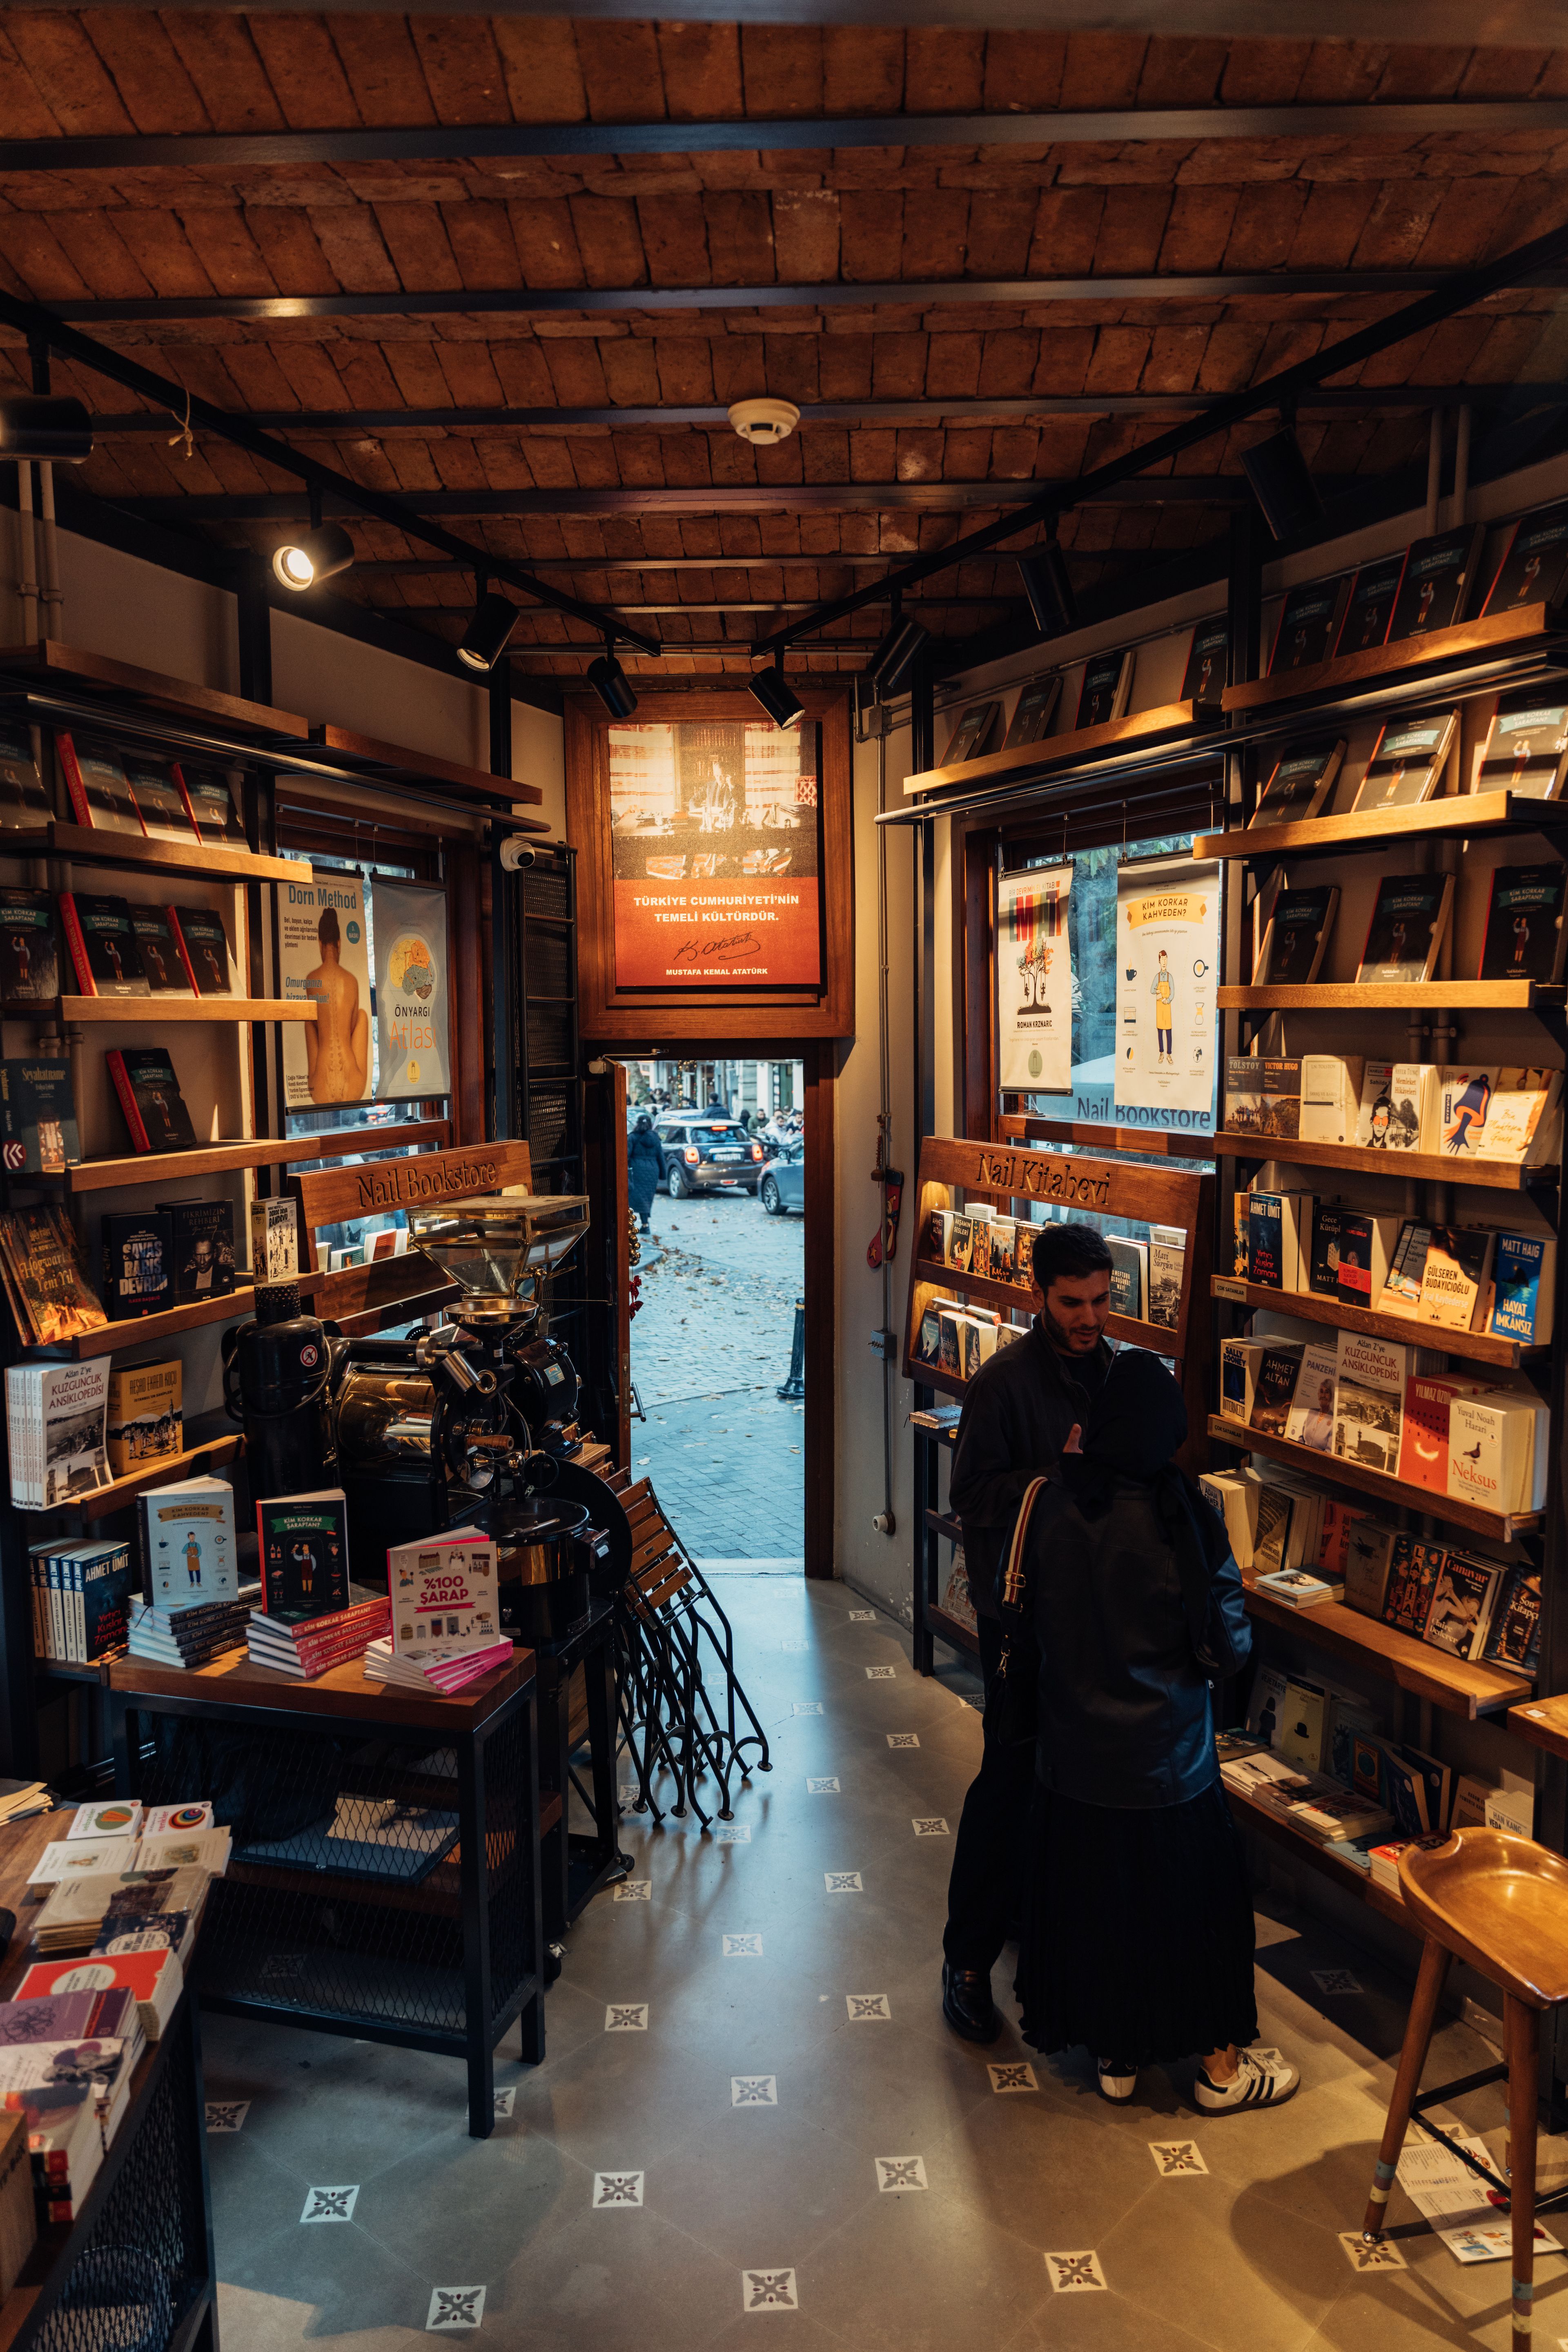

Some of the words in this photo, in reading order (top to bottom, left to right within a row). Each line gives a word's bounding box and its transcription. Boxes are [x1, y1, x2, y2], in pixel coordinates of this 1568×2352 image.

[1017, 884, 1035, 895] DEVRİMİN
[1042, 882, 1056, 890] KİTABI
[289, 885, 314, 905] Dorn
[318, 889, 356, 909] Method
[634, 895, 686, 906] TÜRKİYE
[691, 894, 799, 905] CUMHURİYETİ'NİN
[1143, 900, 1155, 910] KİM
[1158, 898, 1188, 906] KORKAR
[655, 911, 698, 922] TEMELİ
[702, 911, 779, 921] KÜLTÜRDÜR.
[1143, 909, 1186, 920] KAHVEDEN?
[286, 976, 322, 990] Omurganızı
[395, 1004, 430, 1017] ÖNYARGI
[390, 1019, 436, 1050] Atlası
[21, 1067, 66, 1084] Seyahatname
[1078, 1098, 1109, 1120] Nail
[355, 1168, 402, 1209] Nail
[404, 1160, 496, 1199] Bookstore
[977, 1154, 1016, 1189] Nail
[1020, 1160, 1110, 1205] Kitabevi
[183, 1208, 225, 1218] FİKRİMİZİN
[1250, 1202, 1267, 1216] AHMET
[1267, 1203, 1281, 1219] ÜMİT
[189, 1215, 220, 1225] REHBERİ
[269, 1213, 288, 1229] RANDEVU
[933, 1218, 942, 1226] AHMET
[955, 1219, 971, 1228] AKŞAMIN
[1322, 1215, 1337, 1224] Gece
[933, 1227, 942, 1235] ALTAN
[954, 1228, 969, 1236] SESLERİ
[1153, 1249, 1169, 1260] Mavi
[1256, 1249, 1273, 1259] Yırtıcı
[1502, 1238, 1521, 1253] MATT
[1522, 1242, 1540, 1258] HAIG
[1153, 1258, 1173, 1271] Sürgün
[1256, 1258, 1274, 1270] Kuşlar
[36, 1274, 58, 1292] Yeni
[59, 1269, 74, 1285] Yıl
[1115, 1270, 1130, 1279] MEFTUNU
[1253, 1266, 1278, 1279] Zamanı
[1428, 1265, 1457, 1281] GÜLSEREN
[1225, 1287, 1244, 1296] SATANLAR
[1425, 1278, 1469, 1295] BUDAYICIOĞLU
[1503, 1298, 1527, 1316] HAYAT
[1496, 1309, 1532, 1336] İMKÂNSIZ
[1223, 1353, 1246, 1367] ROONEY
[1225, 1346, 1243, 1359] SALLY
[1345, 1346, 1396, 1368] KUZGUNCUK
[1265, 1359, 1295, 1375] AHMET
[1342, 1358, 1399, 1381] ANSİKLOPEDİSİ
[51, 1373, 102, 1396] KUZGUNCUK
[130, 1378, 146, 1396] REŞAD
[147, 1374, 163, 1391] EKREM
[165, 1370, 177, 1388] KOÇU
[1264, 1372, 1290, 1386] ALTAN
[49, 1384, 104, 1409] ANSİKLOPEDİSİ
[156, 1390, 173, 1398] SAHİPLERİ
[1416, 1384, 1436, 1401] YILMAZ
[1223, 1396, 1245, 1418] INTERMEZZO
[1262, 1412, 1275, 1420] Zarlar
[1457, 1406, 1474, 1419] Yuval
[1477, 1413, 1495, 1425] Noah
[1223, 1426, 1241, 1438] SATANLAR
[1465, 1421, 1486, 1434] Harari
[1452, 1459, 1497, 1490] Neksus
[1205, 1487, 1217, 1499] ADAM
[85, 1561, 110, 1583] AHMET
[112, 1552, 129, 1572] ÜMİT
[1447, 1559, 1488, 1584] Canavar
[424, 1575, 463, 1590] %100
[420, 1588, 469, 1604] ŞARAP
[1520, 1596, 1534, 1609] Son
[187, 1609, 198, 1618] KİM
[199, 1604, 222, 1614] KORKAR
[1511, 1601, 1539, 1621] Kitapçı
[97, 1617, 122, 1633] Kuşlar
[304, 1624, 315, 1633] KİM
[316, 1616, 339, 1629] KORKAR
[340, 1607, 371, 1622] ŞARAPTAN?
[1431, 1617, 1452, 1633] Claire
[1430, 1624, 1458, 1644] Dederer
[158, 1811, 169, 1832] renkler
[1493, 1812, 1505, 1823] HAN
[1506, 1820, 1521, 1835] KANG
